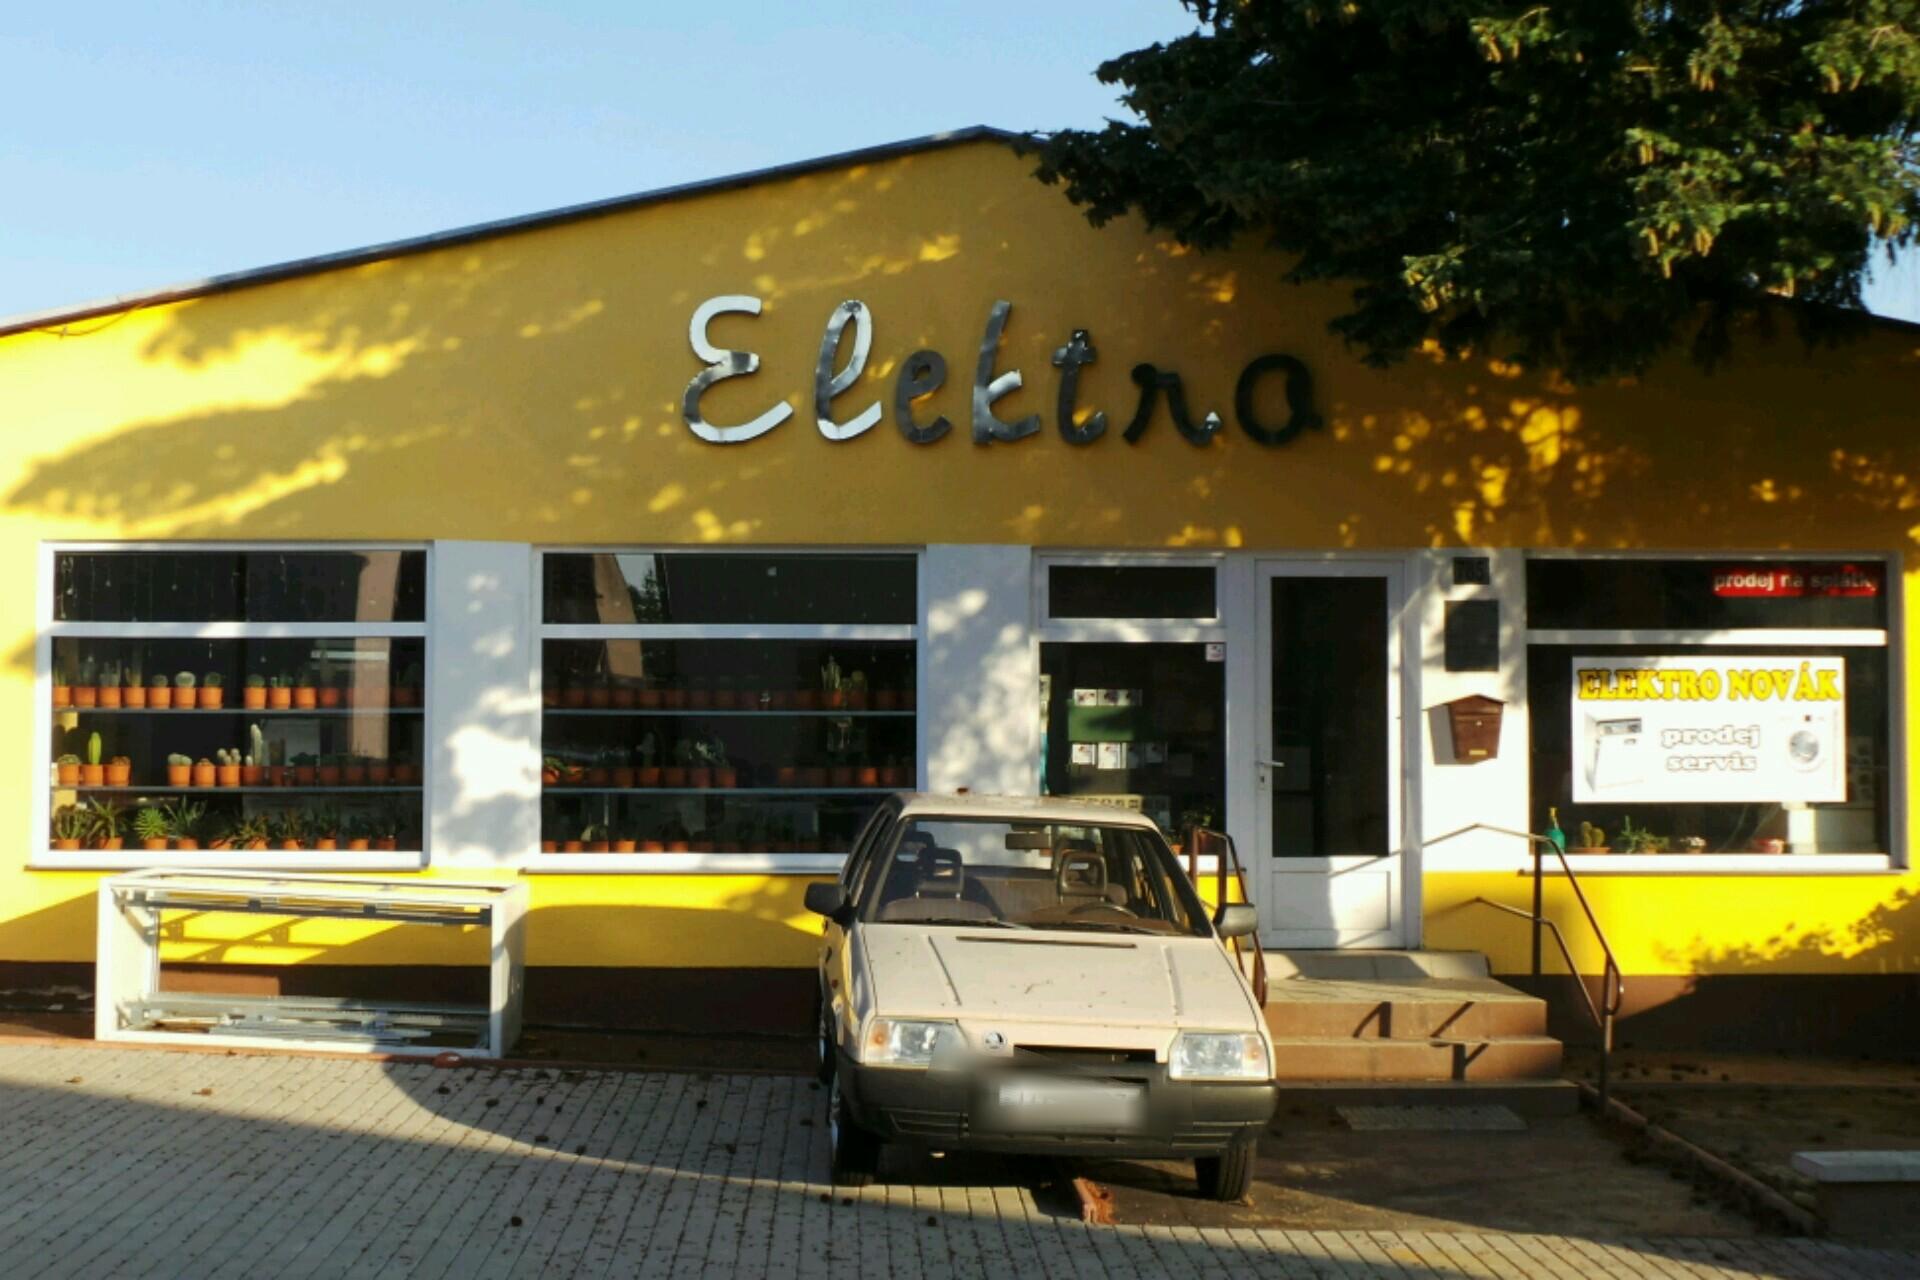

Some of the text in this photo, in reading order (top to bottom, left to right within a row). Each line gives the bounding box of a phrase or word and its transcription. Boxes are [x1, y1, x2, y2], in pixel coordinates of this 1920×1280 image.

[683, 295, 1324, 447] Elektro
[1713, 571, 1775, 592] prodej
[1780, 573, 1804, 588] na
[1578, 661, 1841, 701] ELEKTRO NOVÁK
[1661, 725, 1760, 749] prodej
[1666, 751, 1758, 771] servis
